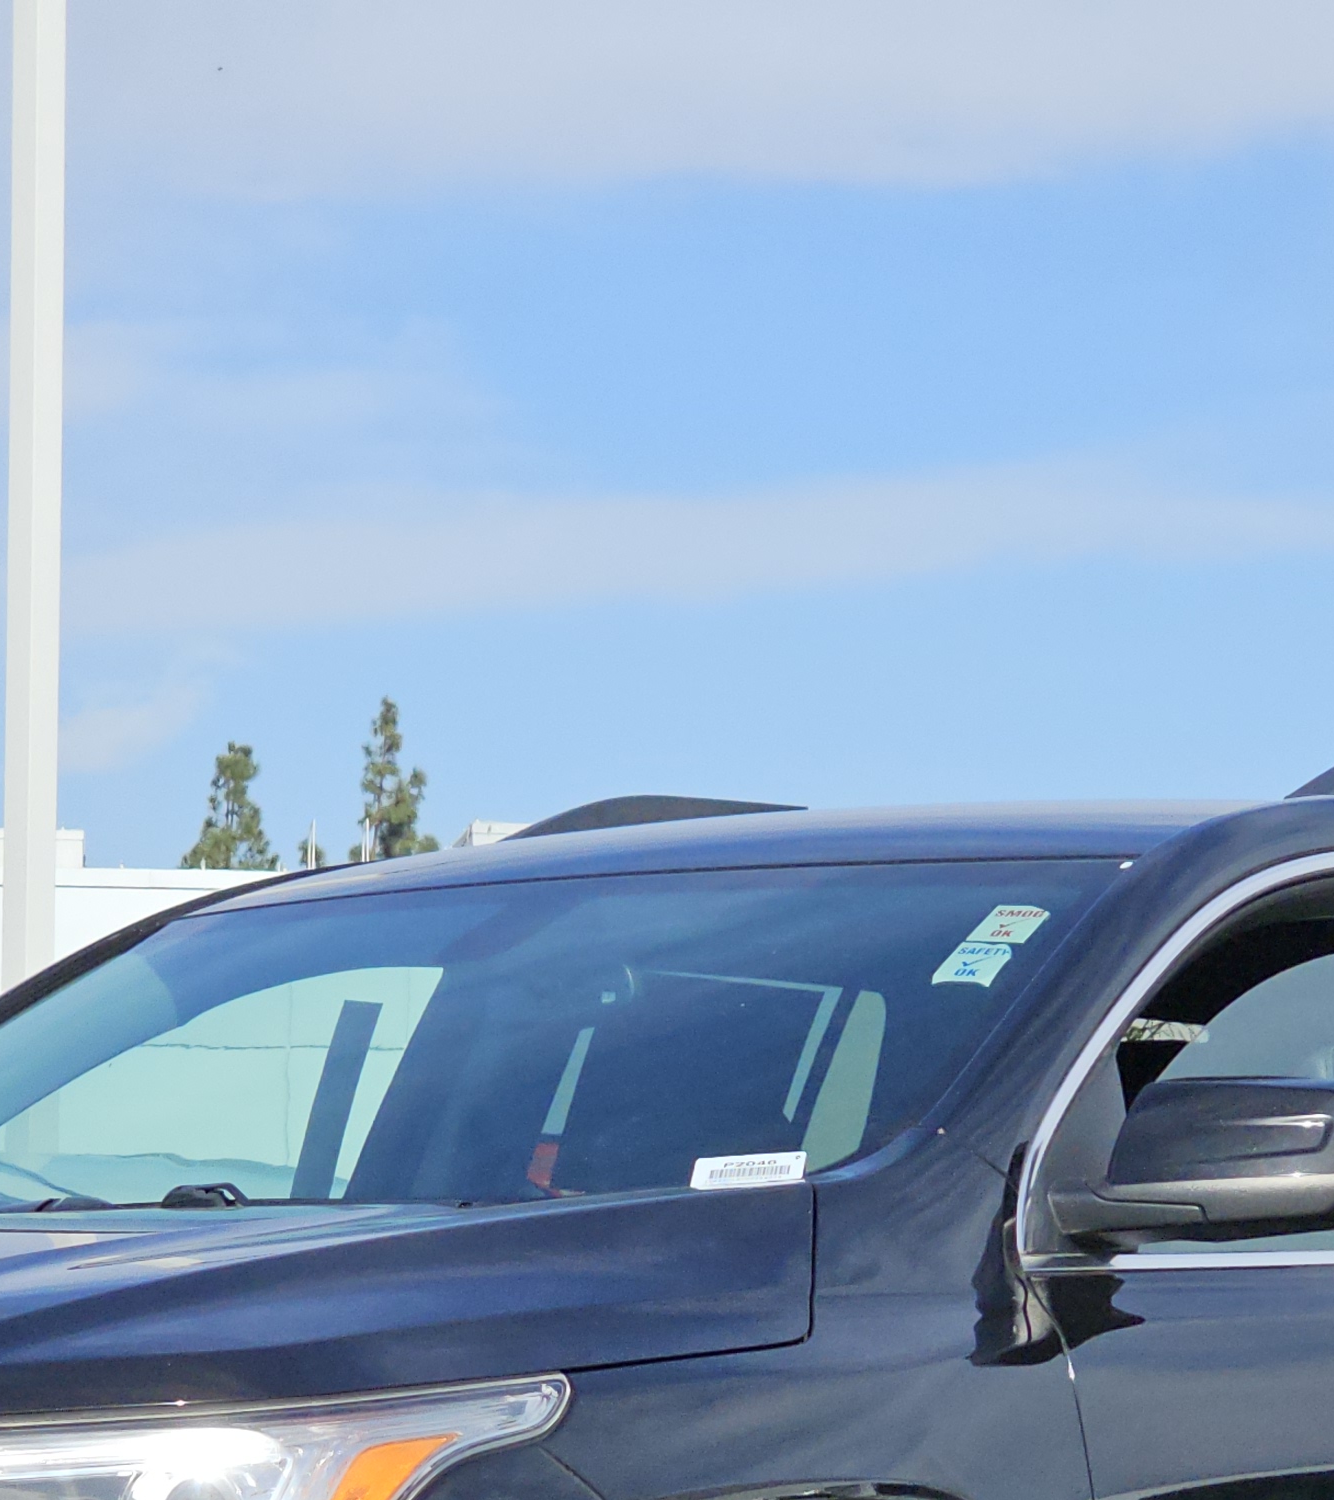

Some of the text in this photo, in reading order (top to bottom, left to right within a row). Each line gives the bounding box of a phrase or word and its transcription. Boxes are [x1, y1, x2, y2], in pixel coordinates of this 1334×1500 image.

[990, 930, 1013, 938] OK
[958, 947, 1010, 956] SAFETY
[953, 968, 979, 977] OK
